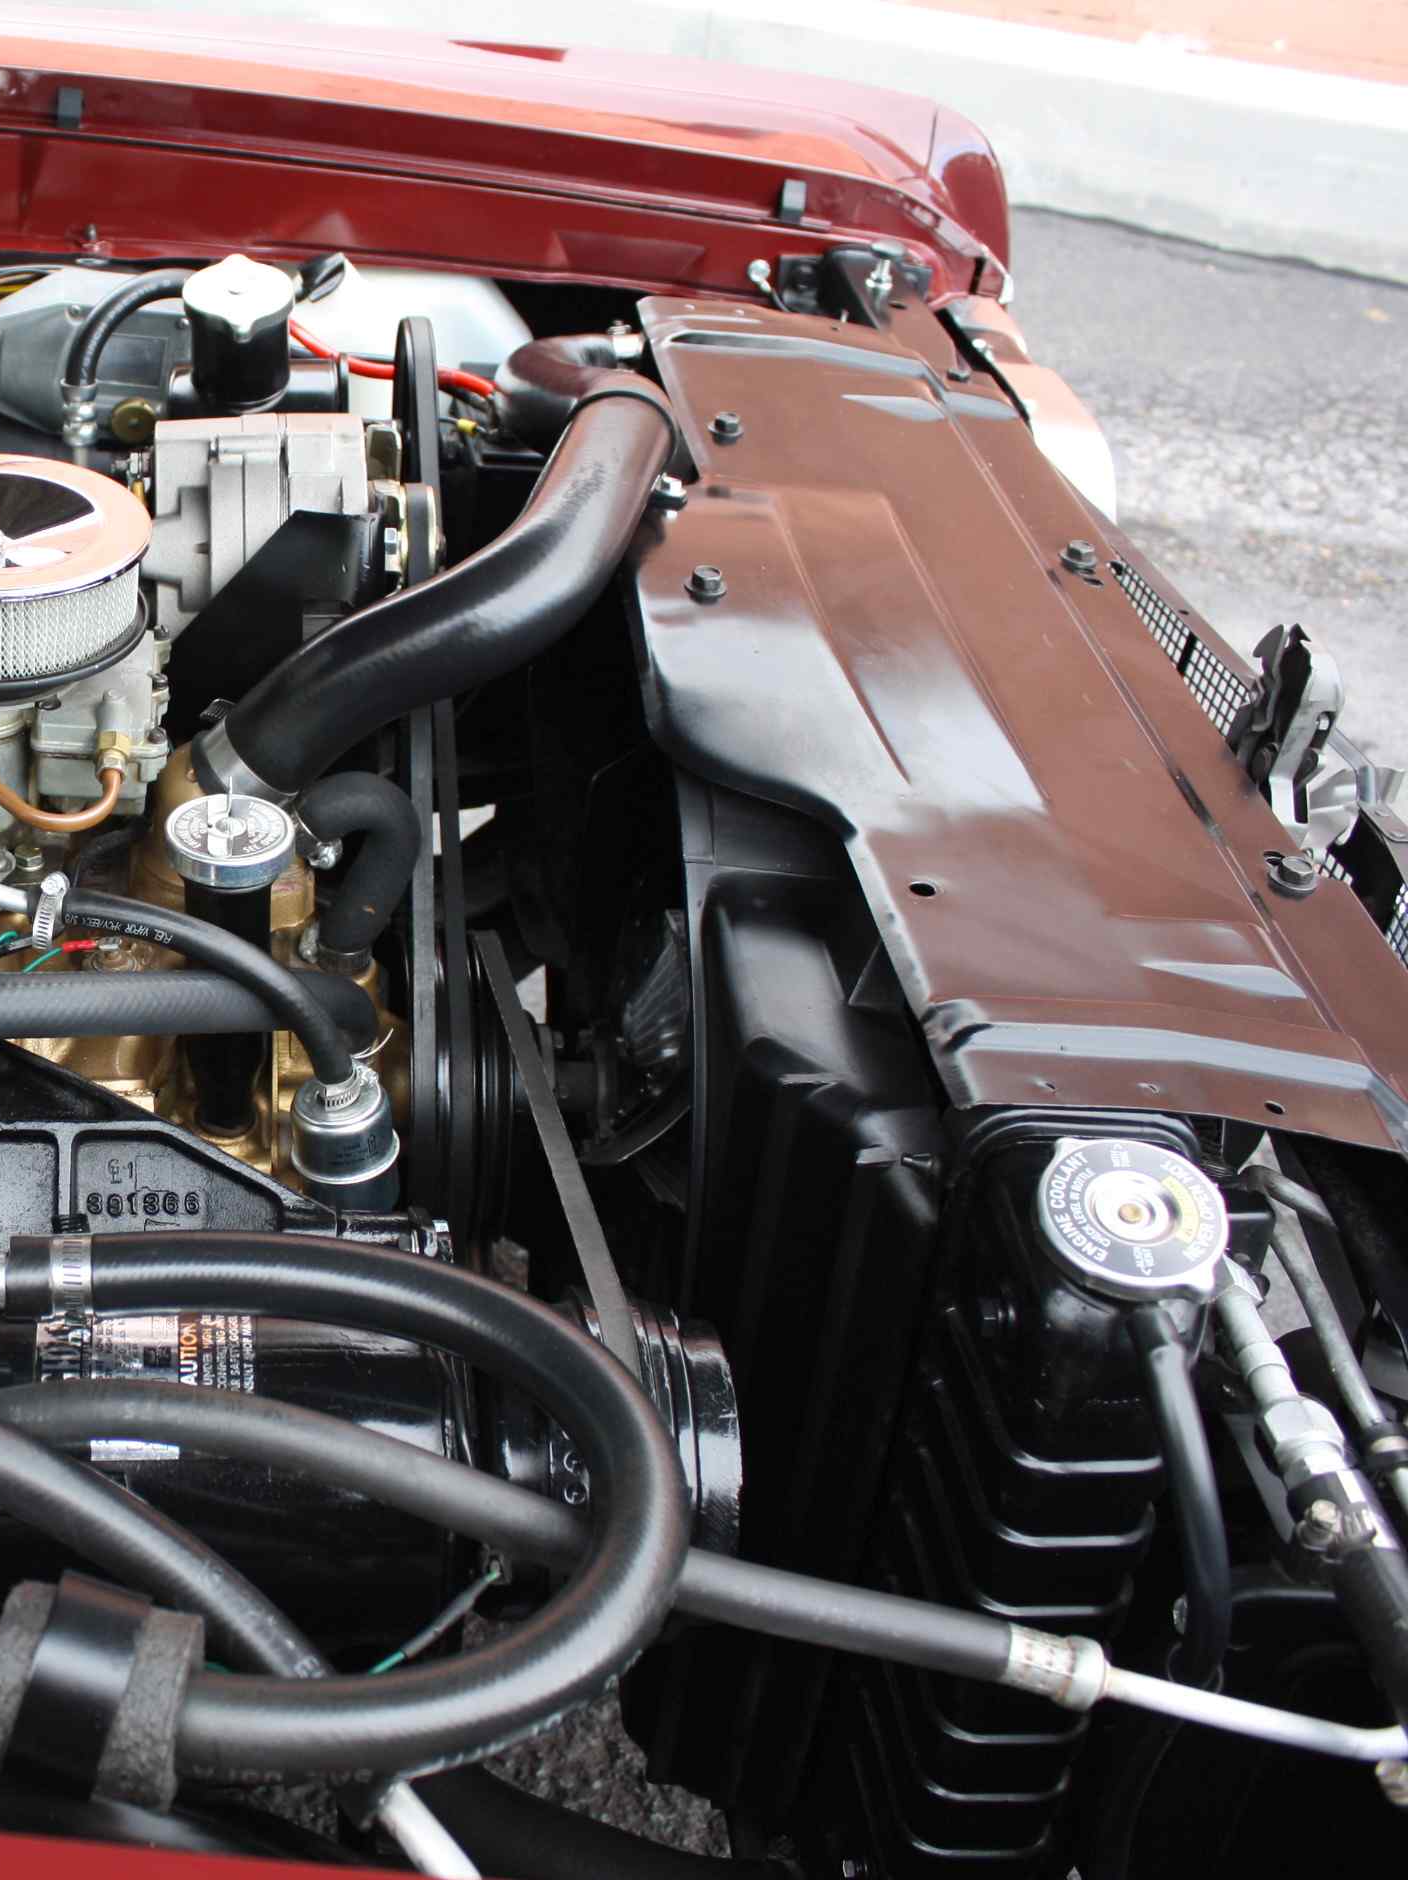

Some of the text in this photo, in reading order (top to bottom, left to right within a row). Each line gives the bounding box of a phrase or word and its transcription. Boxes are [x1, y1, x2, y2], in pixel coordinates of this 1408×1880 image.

[1160, 1160, 1194, 1186] HOT
[1050, 1152, 1109, 1262] ENGINE COOLANT
[1069, 1200, 1087, 1224] LEVEL
[1187, 1182, 1214, 1220] OPEN
[1080, 1221, 1112, 1247] CHECK
[179, 1322, 199, 1386] AUTION
